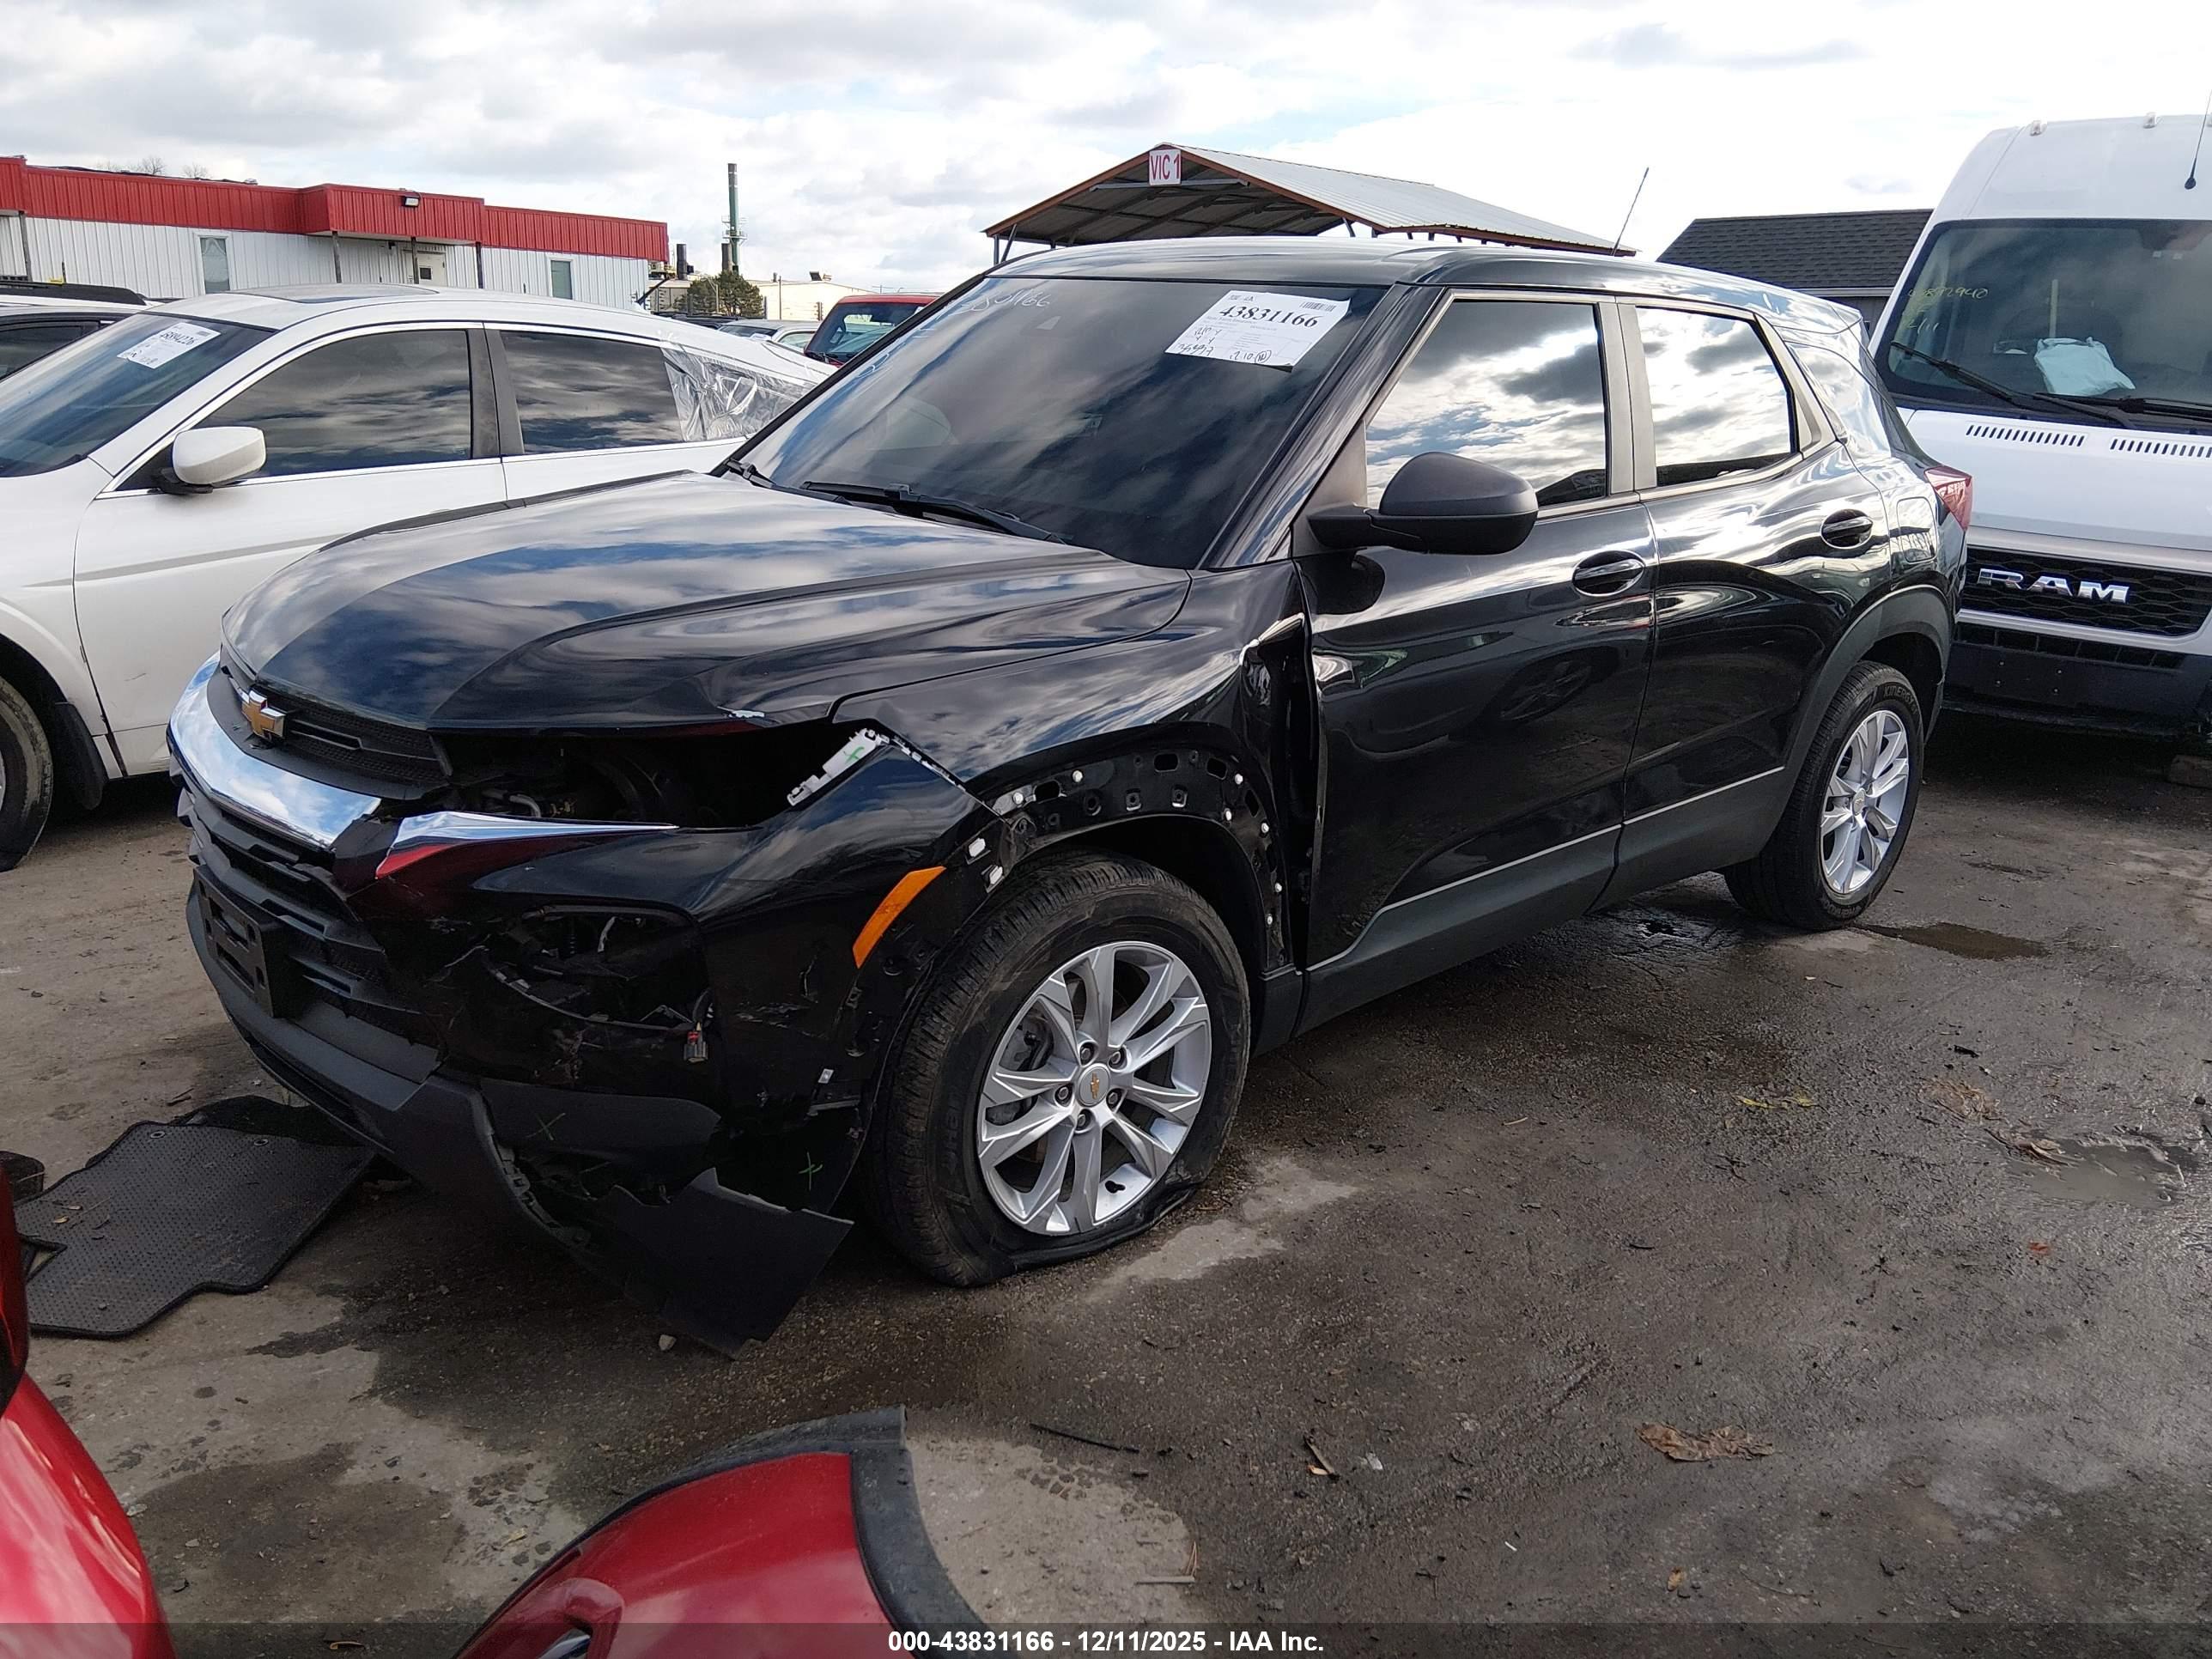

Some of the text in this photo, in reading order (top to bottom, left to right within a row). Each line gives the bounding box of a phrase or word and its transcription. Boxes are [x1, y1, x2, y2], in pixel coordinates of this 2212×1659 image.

[1151, 154, 1180, 180] VIC 1
[1219, 305, 1324, 328] 43831166
[1978, 568, 2130, 604] RAM
